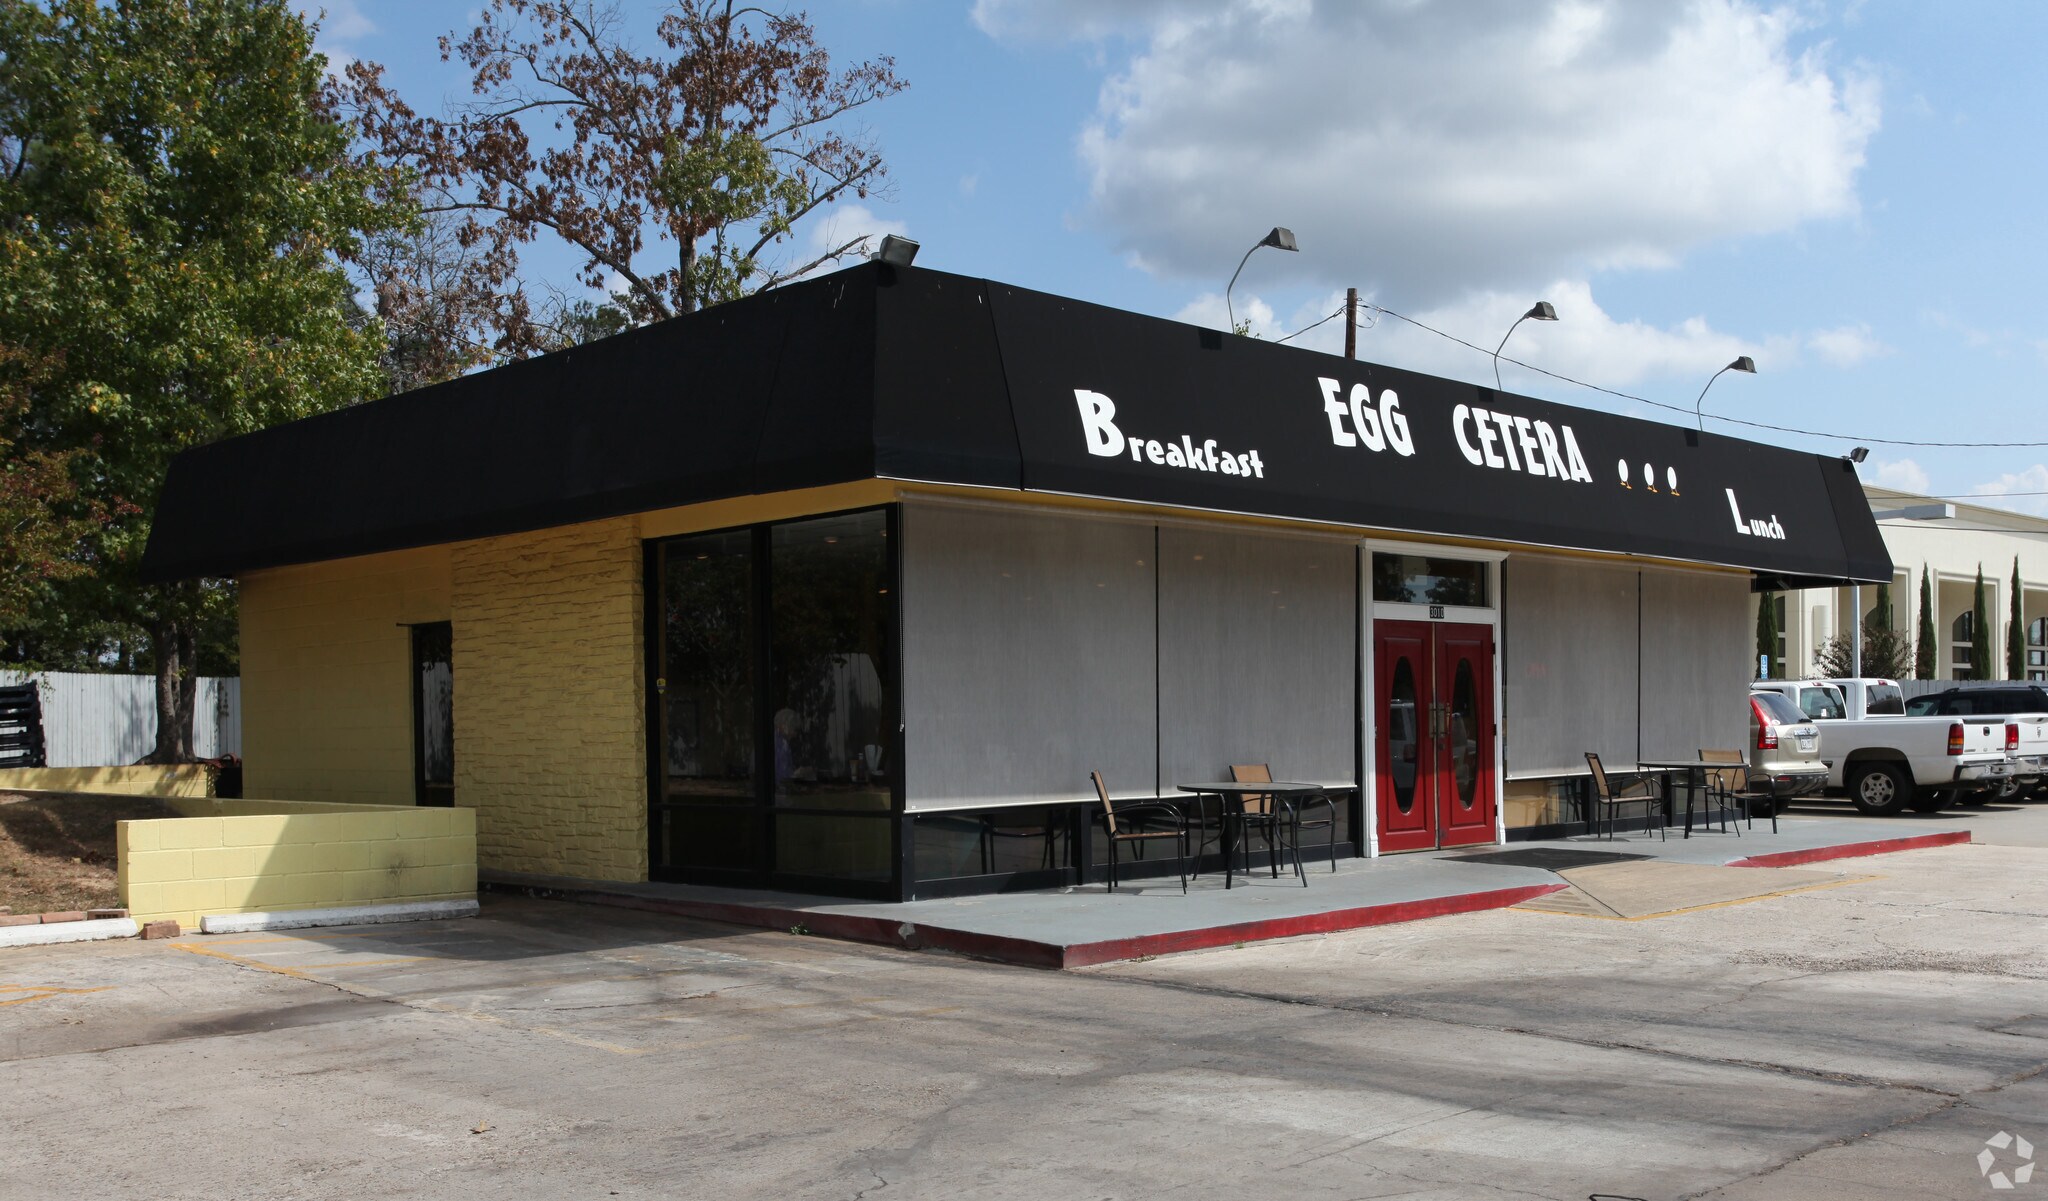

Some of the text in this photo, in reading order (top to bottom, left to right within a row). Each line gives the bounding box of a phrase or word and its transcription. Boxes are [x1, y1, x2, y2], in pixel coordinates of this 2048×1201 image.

[1073, 388, 1264, 479] Breakfast
[1317, 376, 1594, 484] EGG CETERA
[1725, 487, 1786, 540] Lunch
[1430, 607, 1444, 618] 3010
